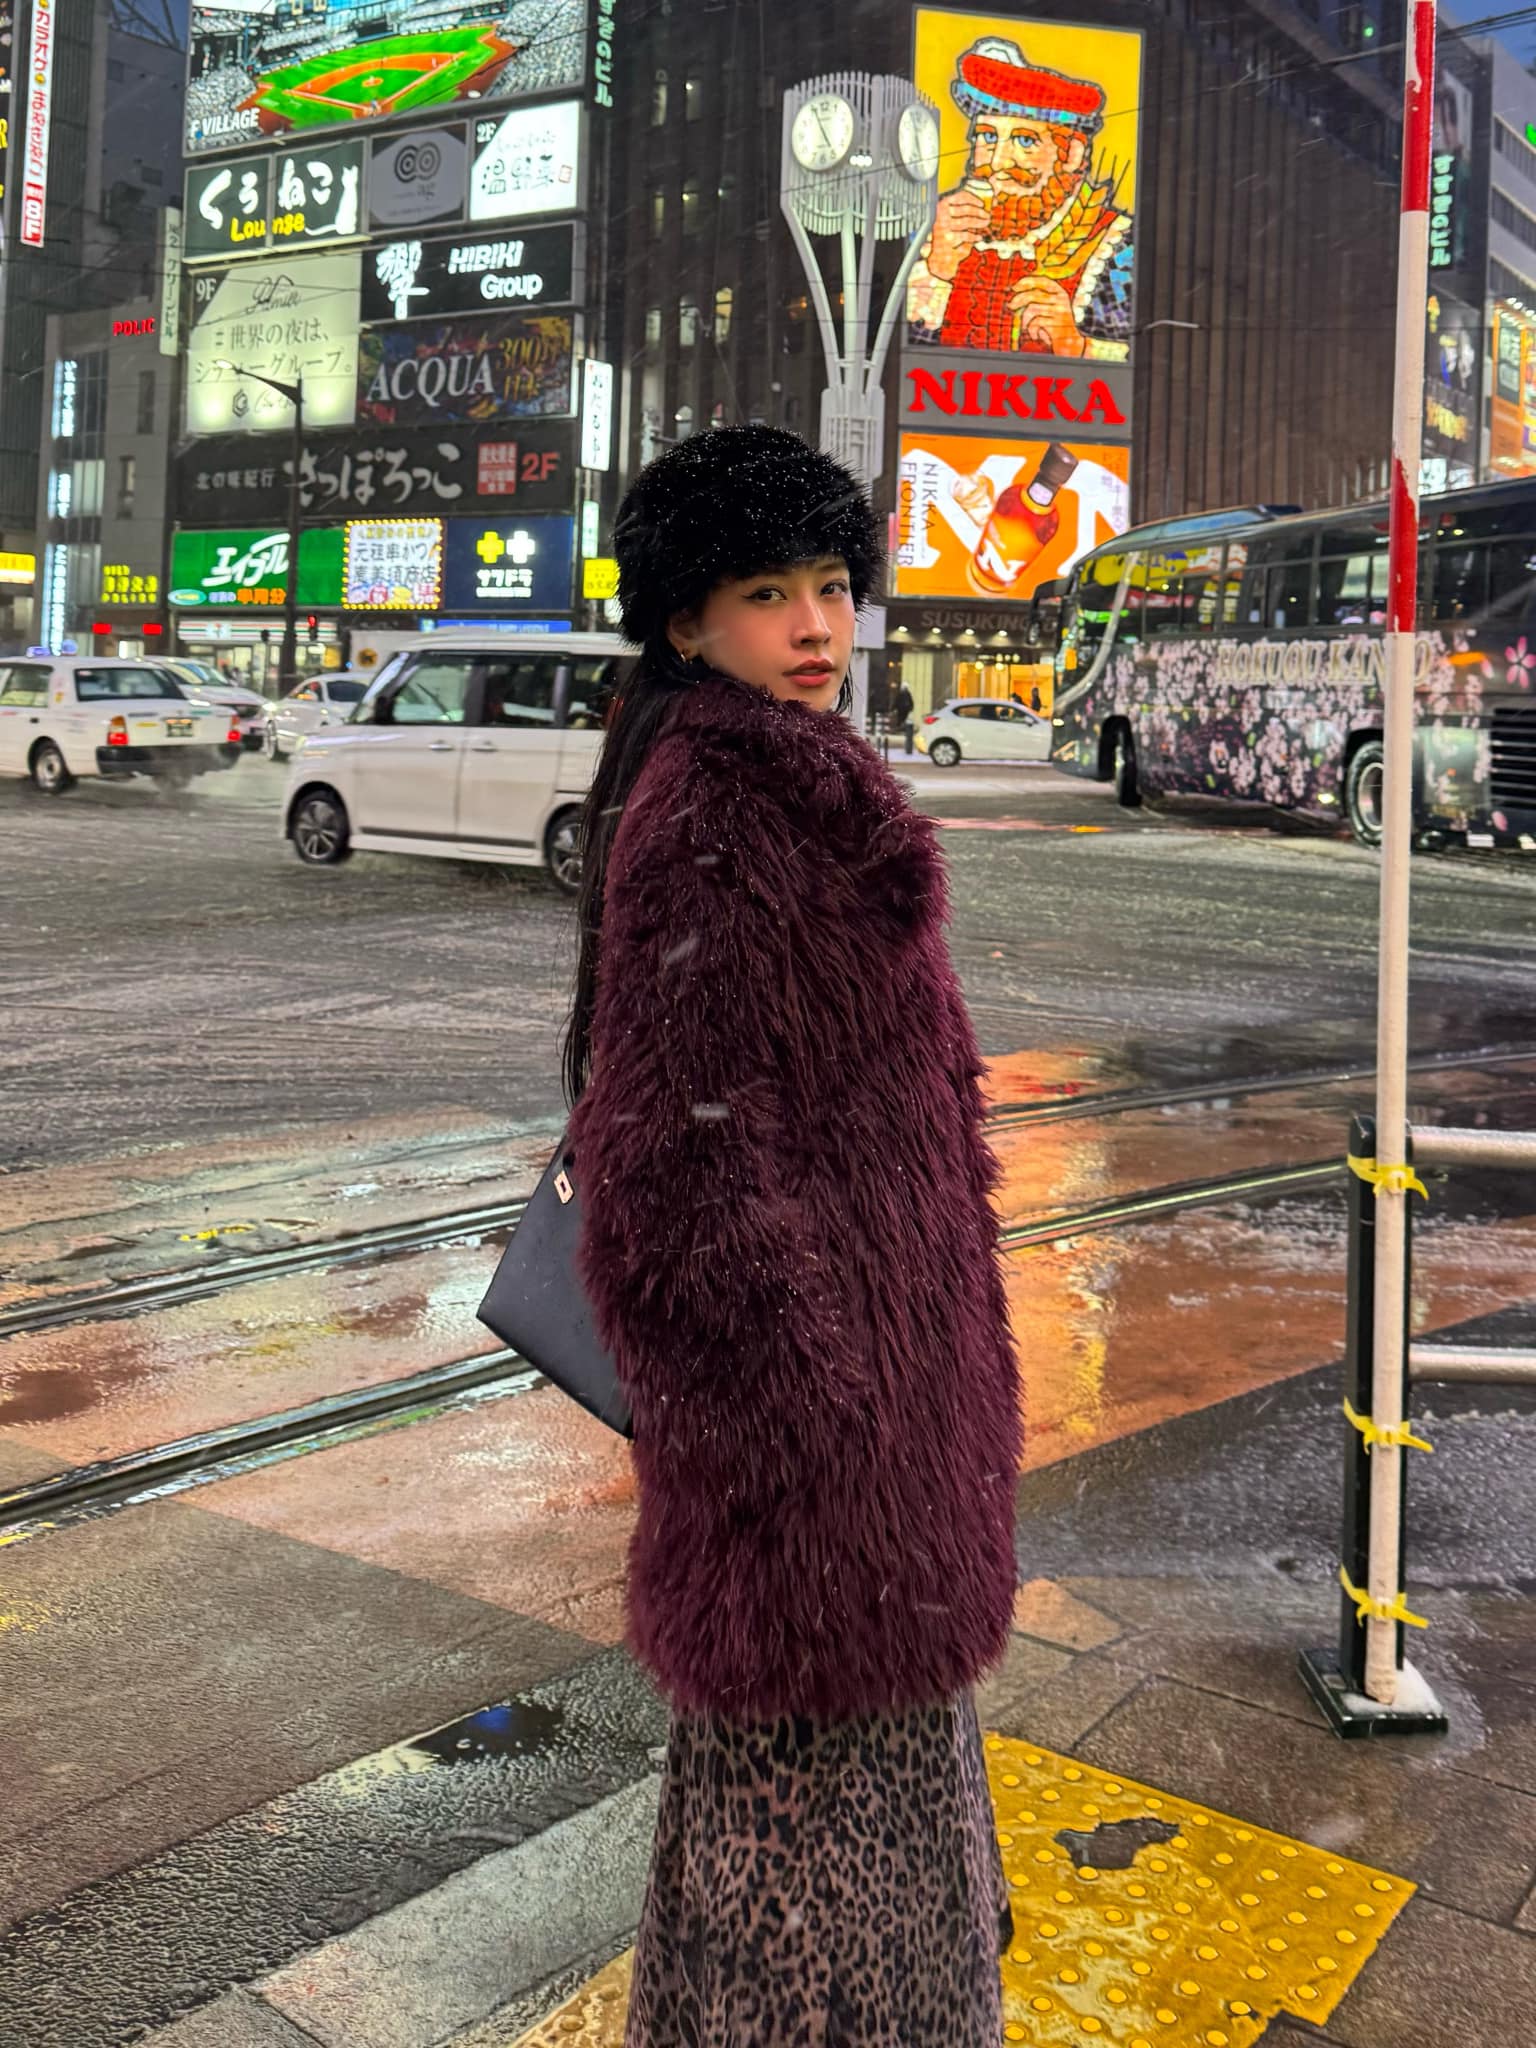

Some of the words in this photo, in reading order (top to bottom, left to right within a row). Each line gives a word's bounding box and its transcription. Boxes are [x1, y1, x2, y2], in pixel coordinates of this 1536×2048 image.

[202, 107, 260, 134] VILLAGE
[198, 157, 333, 230] くろねこ
[448, 240, 525, 274] HIBIKI
[195, 278, 217, 302] 9F
[480, 272, 544, 301] Group
[366, 352, 497, 408] ACQUA
[905, 367, 1127, 425] NIKKA
[520, 452, 560, 482] 2F
[900, 461, 919, 567] FRONTIER
[921, 462, 938, 531] NIKKA
[201, 533, 291, 587] エイブル
[1327, 639, 1433, 687] KANO
